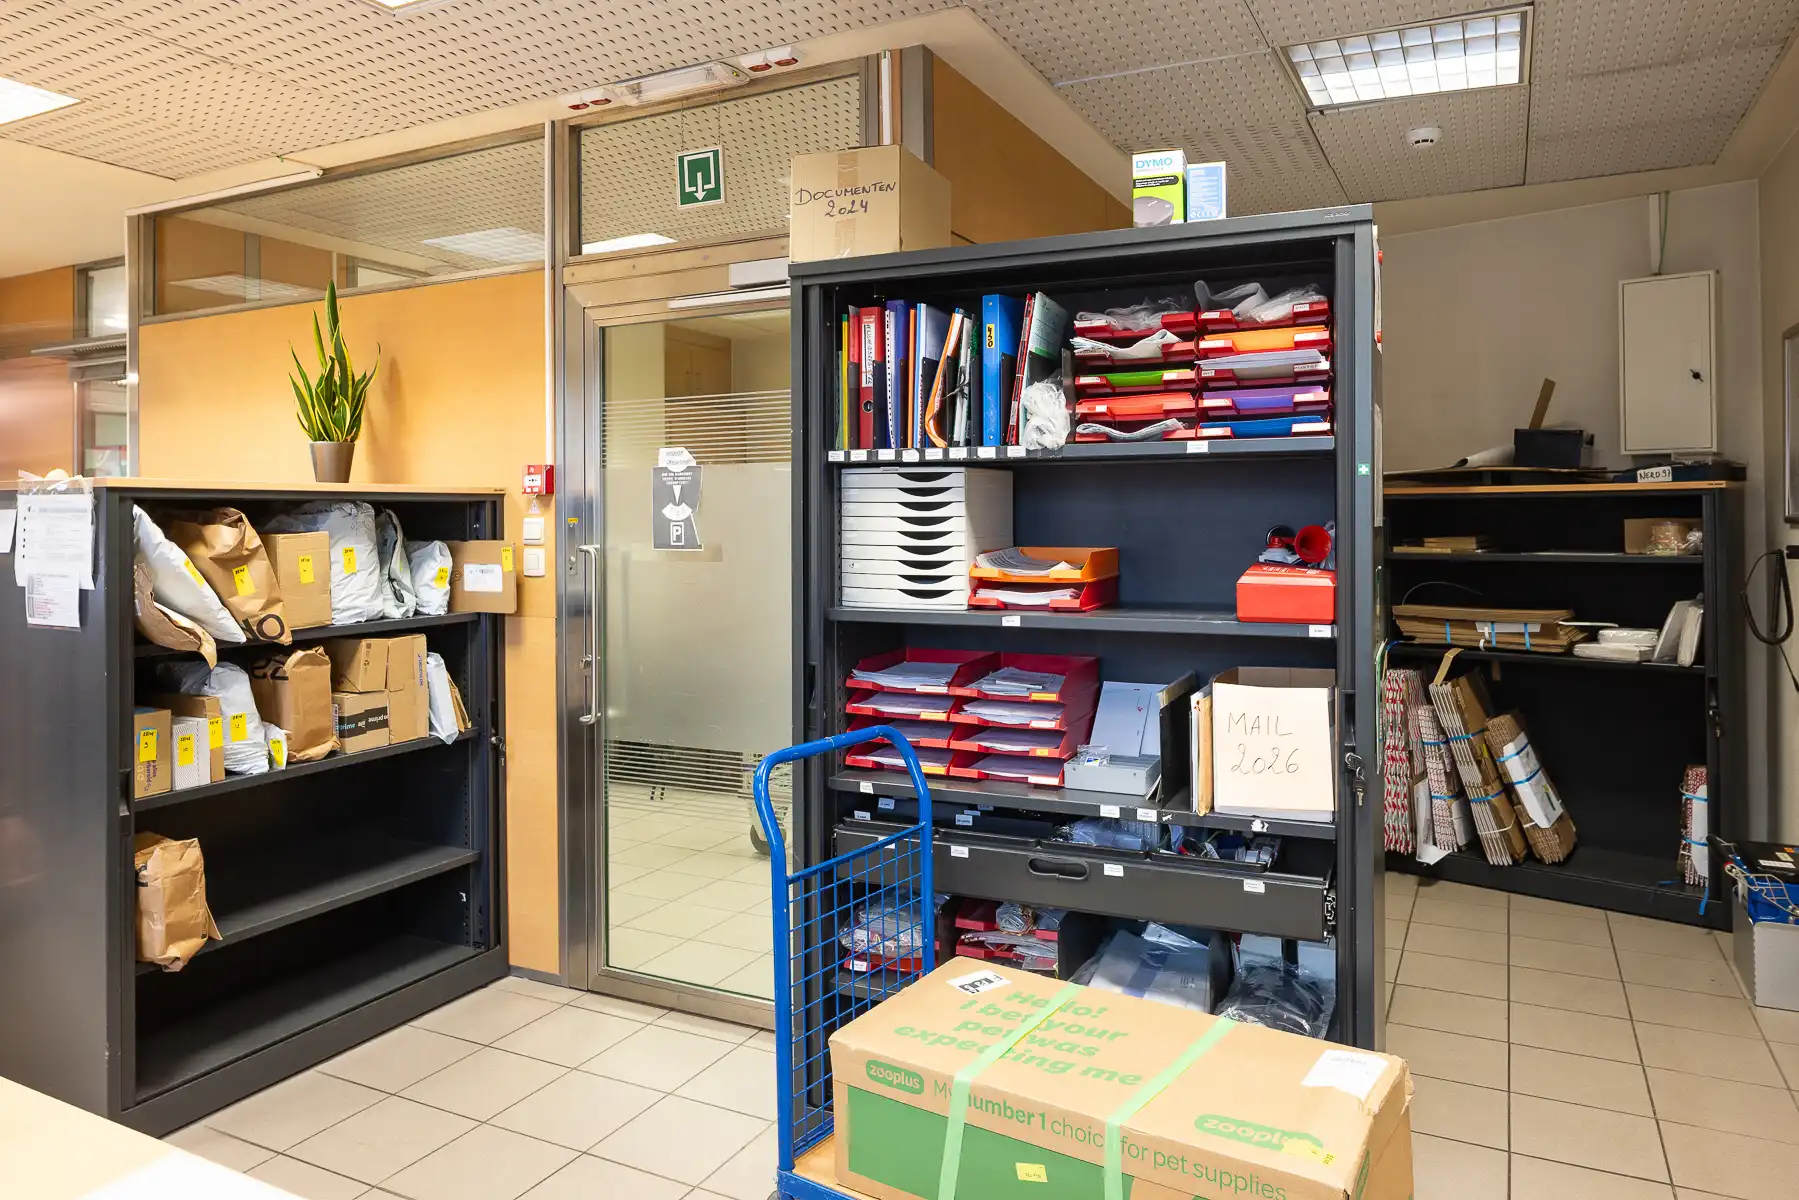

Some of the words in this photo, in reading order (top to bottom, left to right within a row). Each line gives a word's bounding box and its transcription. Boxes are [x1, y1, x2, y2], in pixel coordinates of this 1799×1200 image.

[1135, 157, 1173, 169] DYMO
[794, 181, 897, 206] DOCUMENTEN
[824, 199, 869, 218] 2024
[1639, 470, 1660, 480] NERO
[672, 525, 682, 542] P
[1228, 712, 1292, 736] MAIL
[1231, 743, 1300, 774] 2026
[1003, 990, 1109, 1018] Helo!
[960, 1000, 979, 1011] I
[1037, 1019, 1130, 1042] your
[893, 1024, 1077, 1075] expeing
[1078, 1066, 1144, 1086] me
[1026, 1034, 1101, 1058] was
[869, 1063, 921, 1090] zooplus
[1202, 1118, 1290, 1145] zoopl
[1038, 1112, 1046, 1130] 1
[1050, 1117, 1104, 1148] choic
[1119, 1136, 1149, 1161] for
[1153, 1149, 1189, 1176] pet
[1193, 1161, 1287, 1200] supplies
